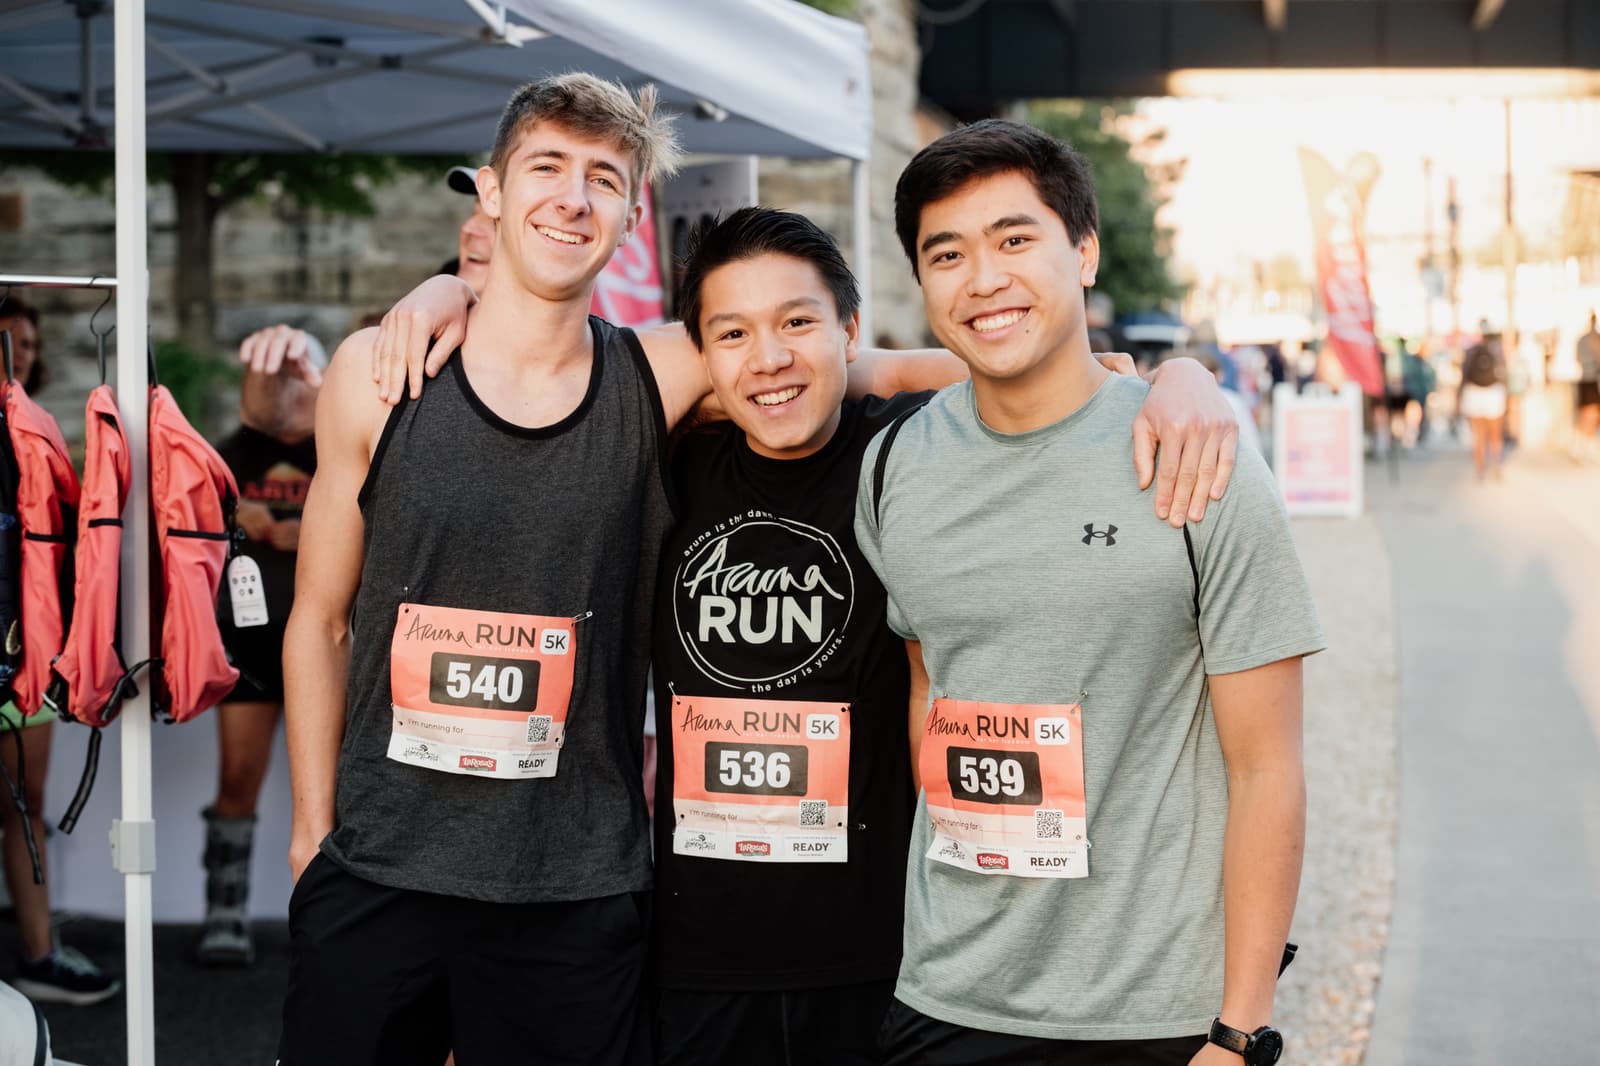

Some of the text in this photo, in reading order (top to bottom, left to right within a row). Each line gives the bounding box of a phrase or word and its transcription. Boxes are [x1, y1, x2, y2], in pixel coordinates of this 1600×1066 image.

[683, 531, 711, 557] aruna
[715, 523, 726, 533] is
[699, 595, 823, 645] RUN
[475, 623, 536, 648] RUN
[544, 635, 567, 650] 5K
[751, 635, 845, 693] the day is yours.
[446, 661, 524, 704] 540
[420, 721, 450, 734] running
[452, 725, 464, 734] for
[743, 711, 800, 733] RUN
[810, 720, 835, 735] 5K
[976, 715, 1029, 738] RUN
[1039, 724, 1065, 739] 5K
[519, 759, 545, 769] READY
[719, 750, 791, 788] 536
[959, 755, 1025, 797] 539
[793, 842, 829, 852] READY
[1030, 857, 1068, 867] READY
